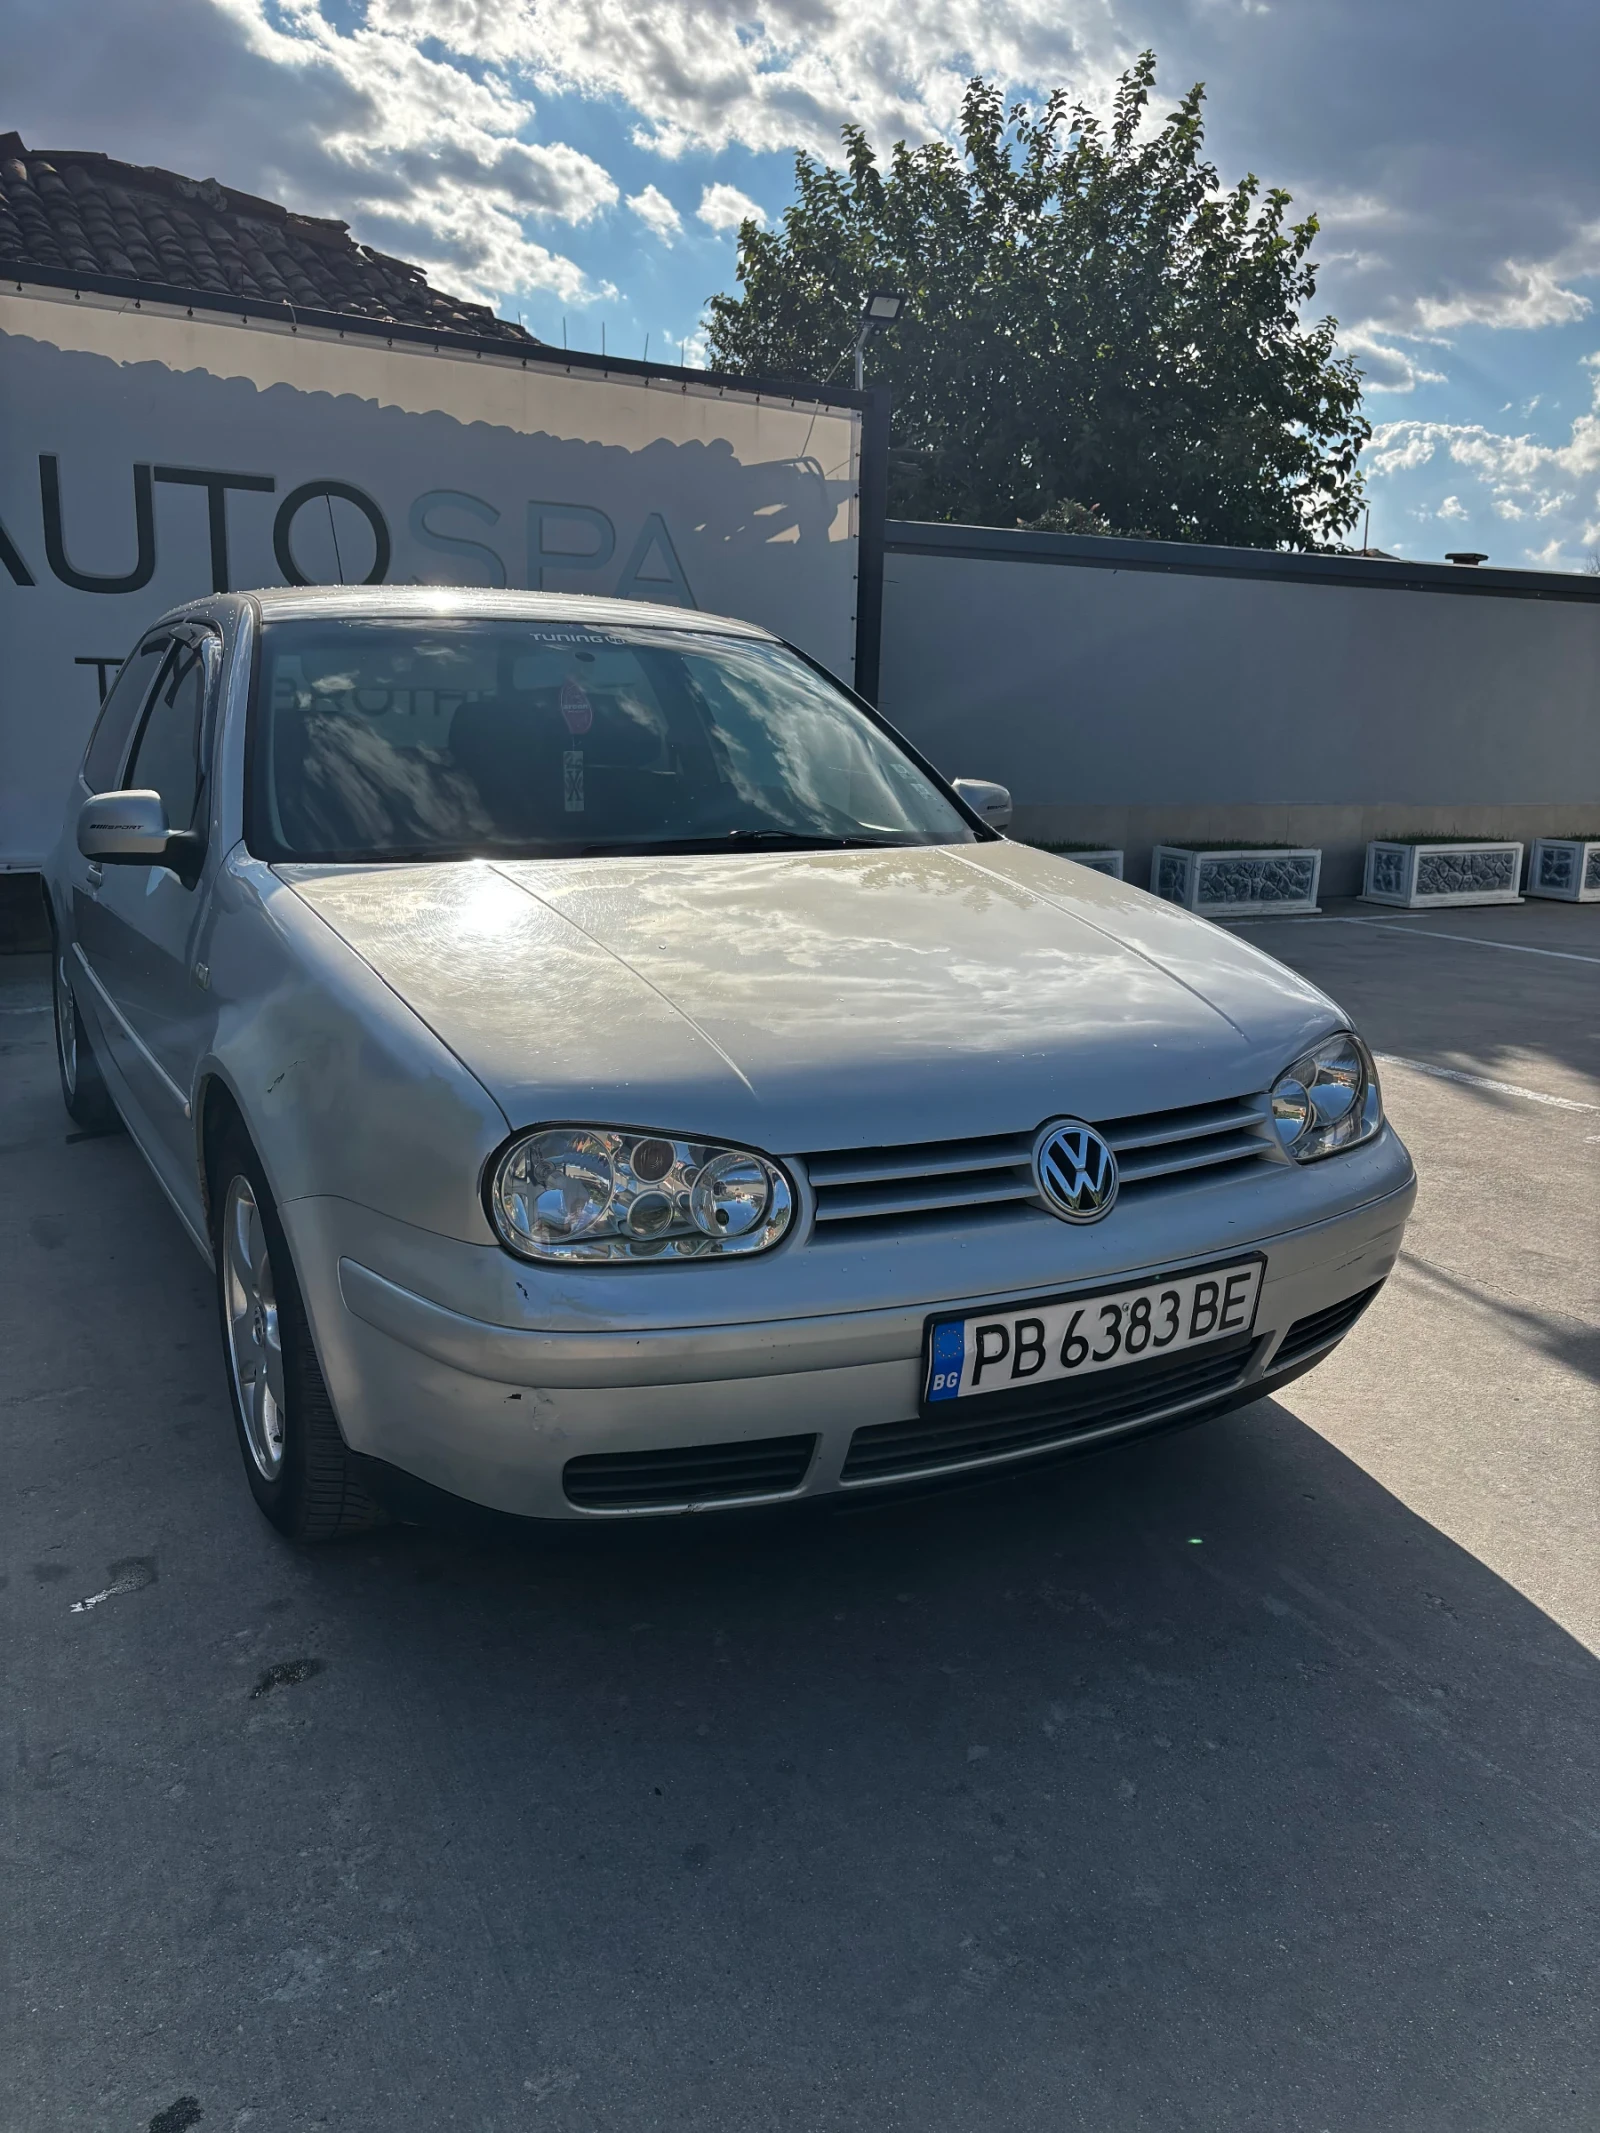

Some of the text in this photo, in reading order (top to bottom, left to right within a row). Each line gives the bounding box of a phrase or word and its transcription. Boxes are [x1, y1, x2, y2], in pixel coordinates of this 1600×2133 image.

[0, 454, 698, 610] UTOSPA
[933, 1373, 958, 1391] BG
[971, 1272, 1252, 1386] PB 6383 BE
